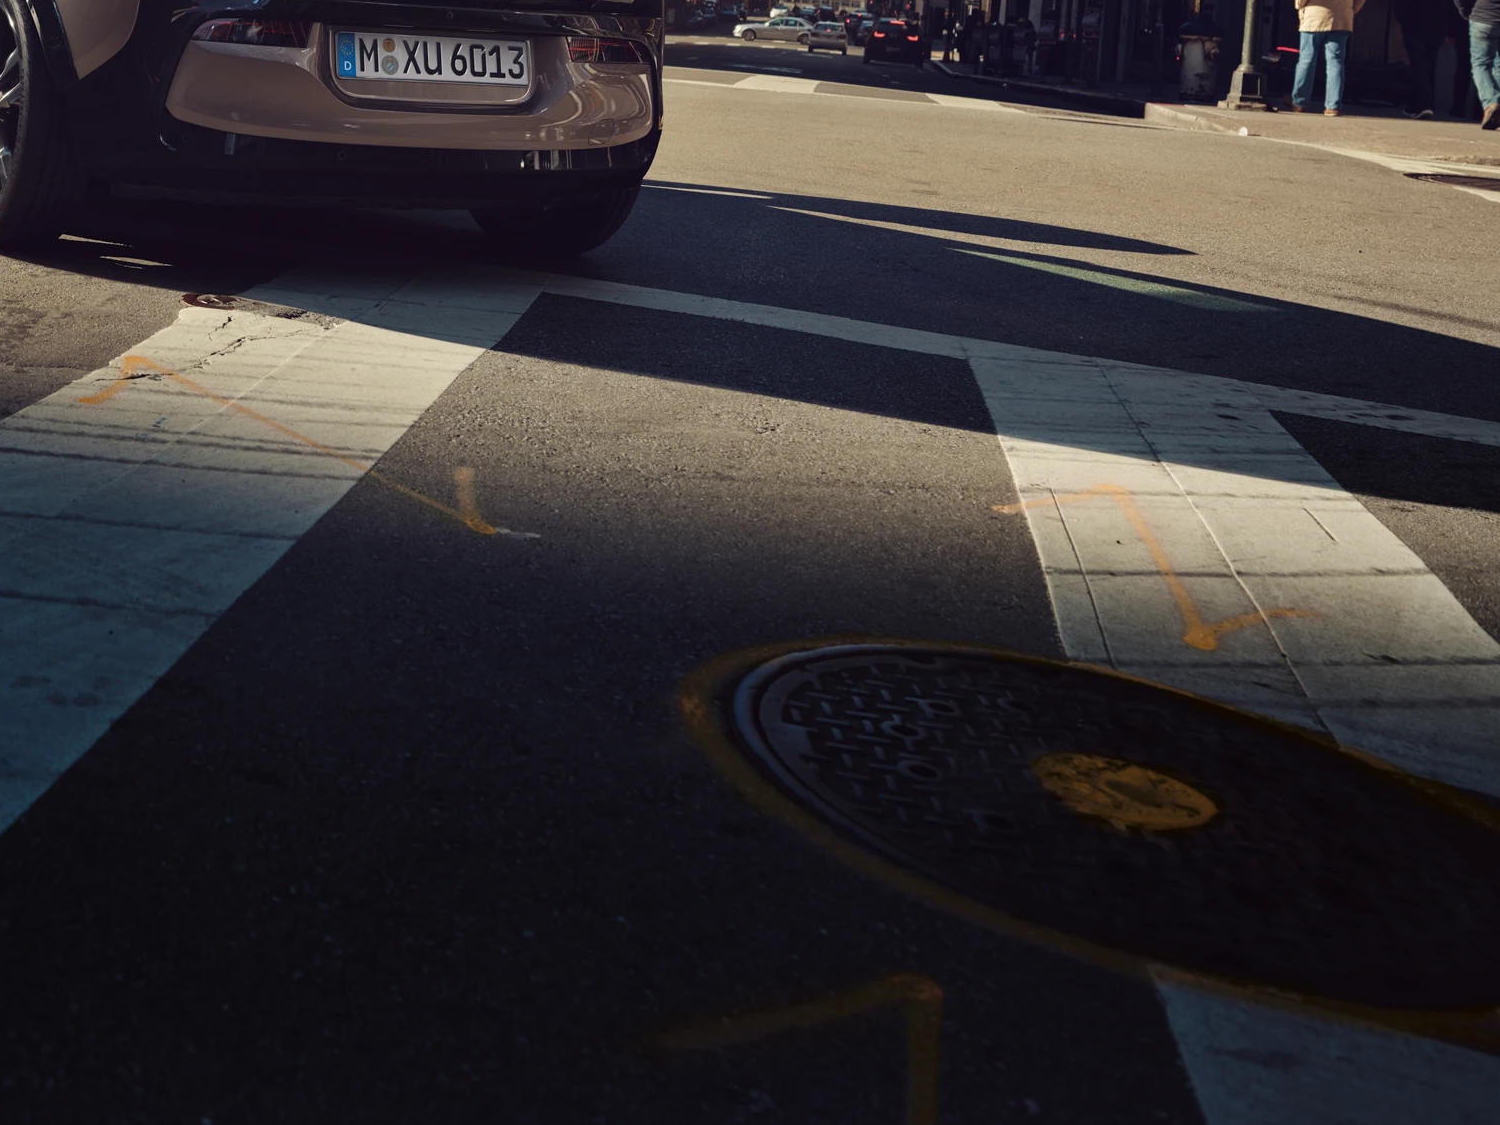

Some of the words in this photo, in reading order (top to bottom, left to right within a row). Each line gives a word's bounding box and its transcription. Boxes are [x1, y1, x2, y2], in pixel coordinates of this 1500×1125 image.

[343, 60, 352, 71] D
[358, 38, 380, 73] M
[402, 39, 443, 76] XU
[450, 42, 525, 80] 6013
